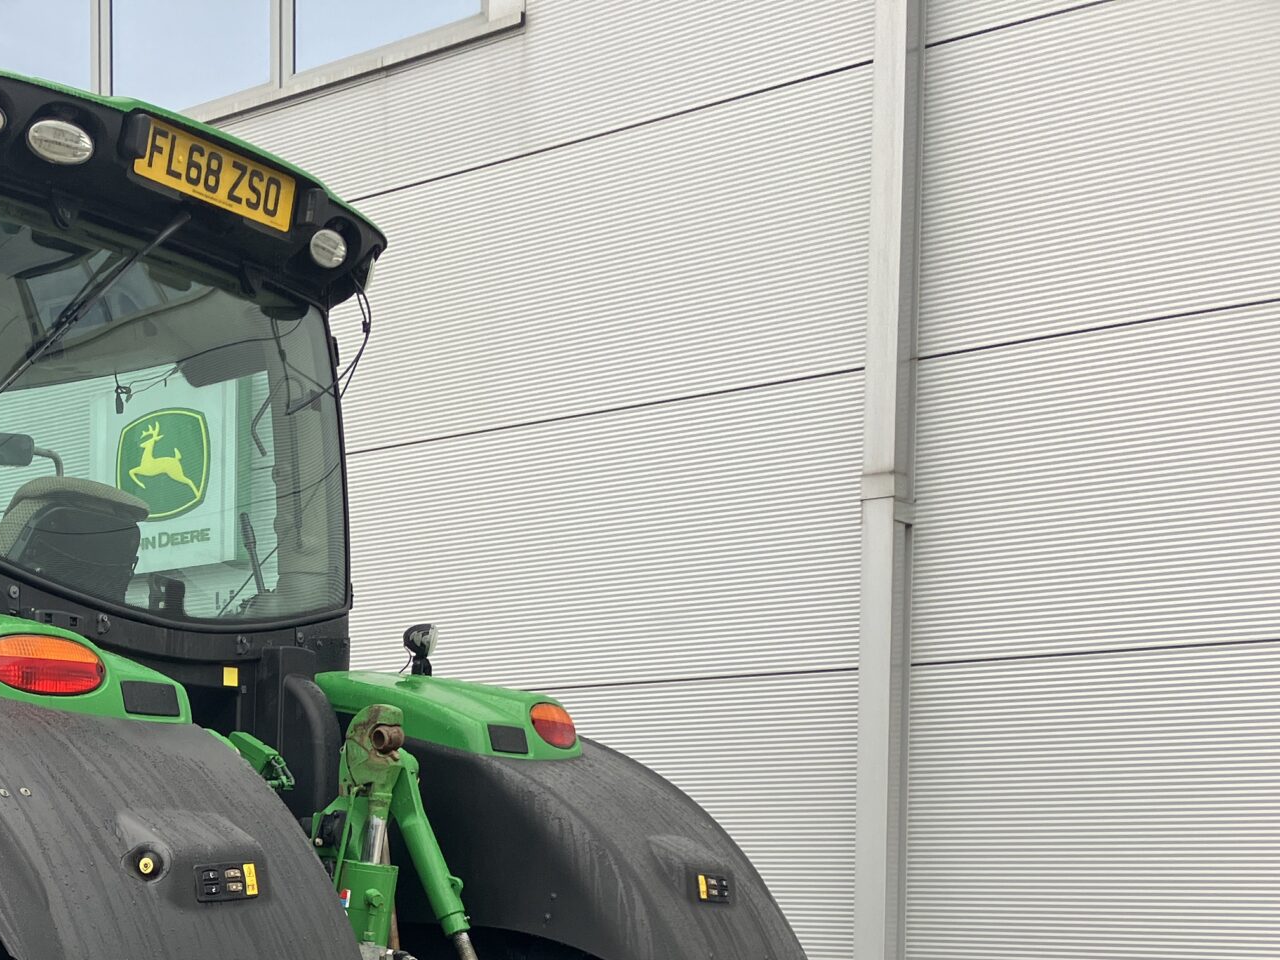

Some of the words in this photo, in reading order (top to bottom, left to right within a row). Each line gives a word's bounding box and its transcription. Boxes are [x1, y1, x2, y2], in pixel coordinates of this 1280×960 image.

[147, 126, 224, 194] FL68
[227, 160, 282, 218] ZSO
[158, 527, 211, 548] DEERE
